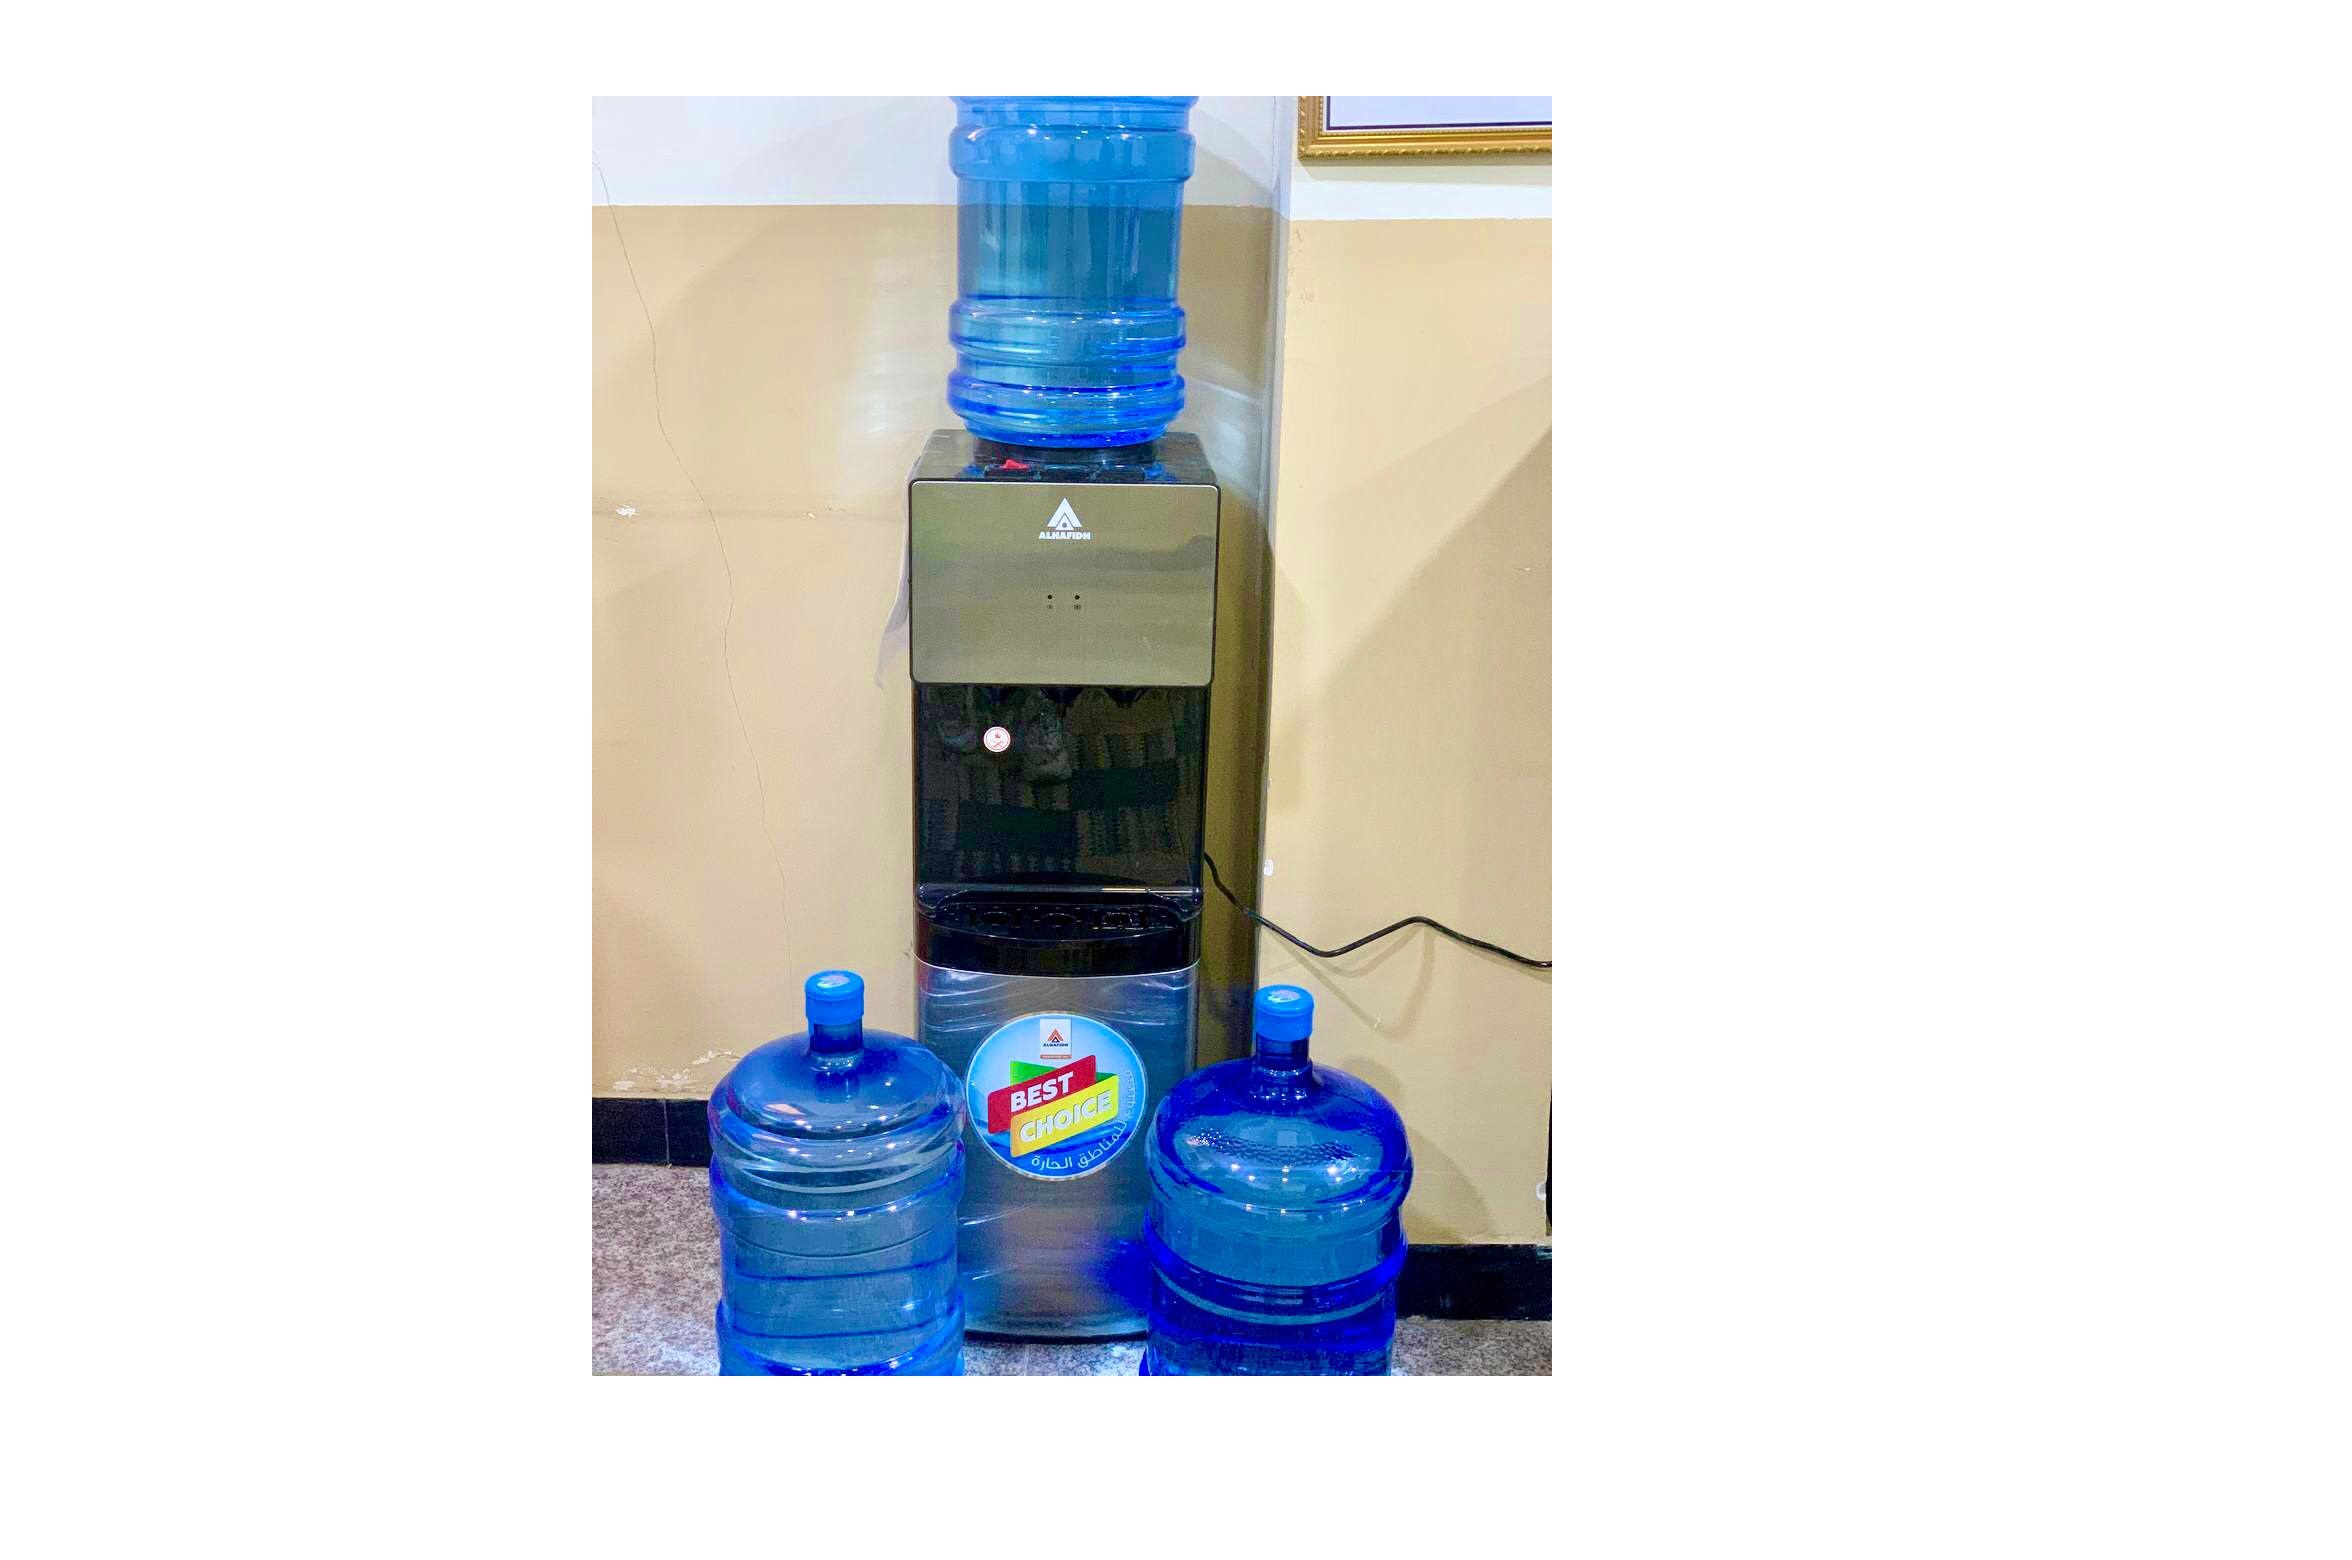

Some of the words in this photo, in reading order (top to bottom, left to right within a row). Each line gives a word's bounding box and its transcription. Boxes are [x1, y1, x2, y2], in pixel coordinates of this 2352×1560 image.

[1039, 531, 1091, 540] ALHAFIDH
[1010, 1071, 1074, 1112] BEST
[1019, 1089, 1113, 1143] CHOICE
[1031, 1153, 1073, 1171] الحارة
[1077, 1119, 1128, 1169] للمناطق
